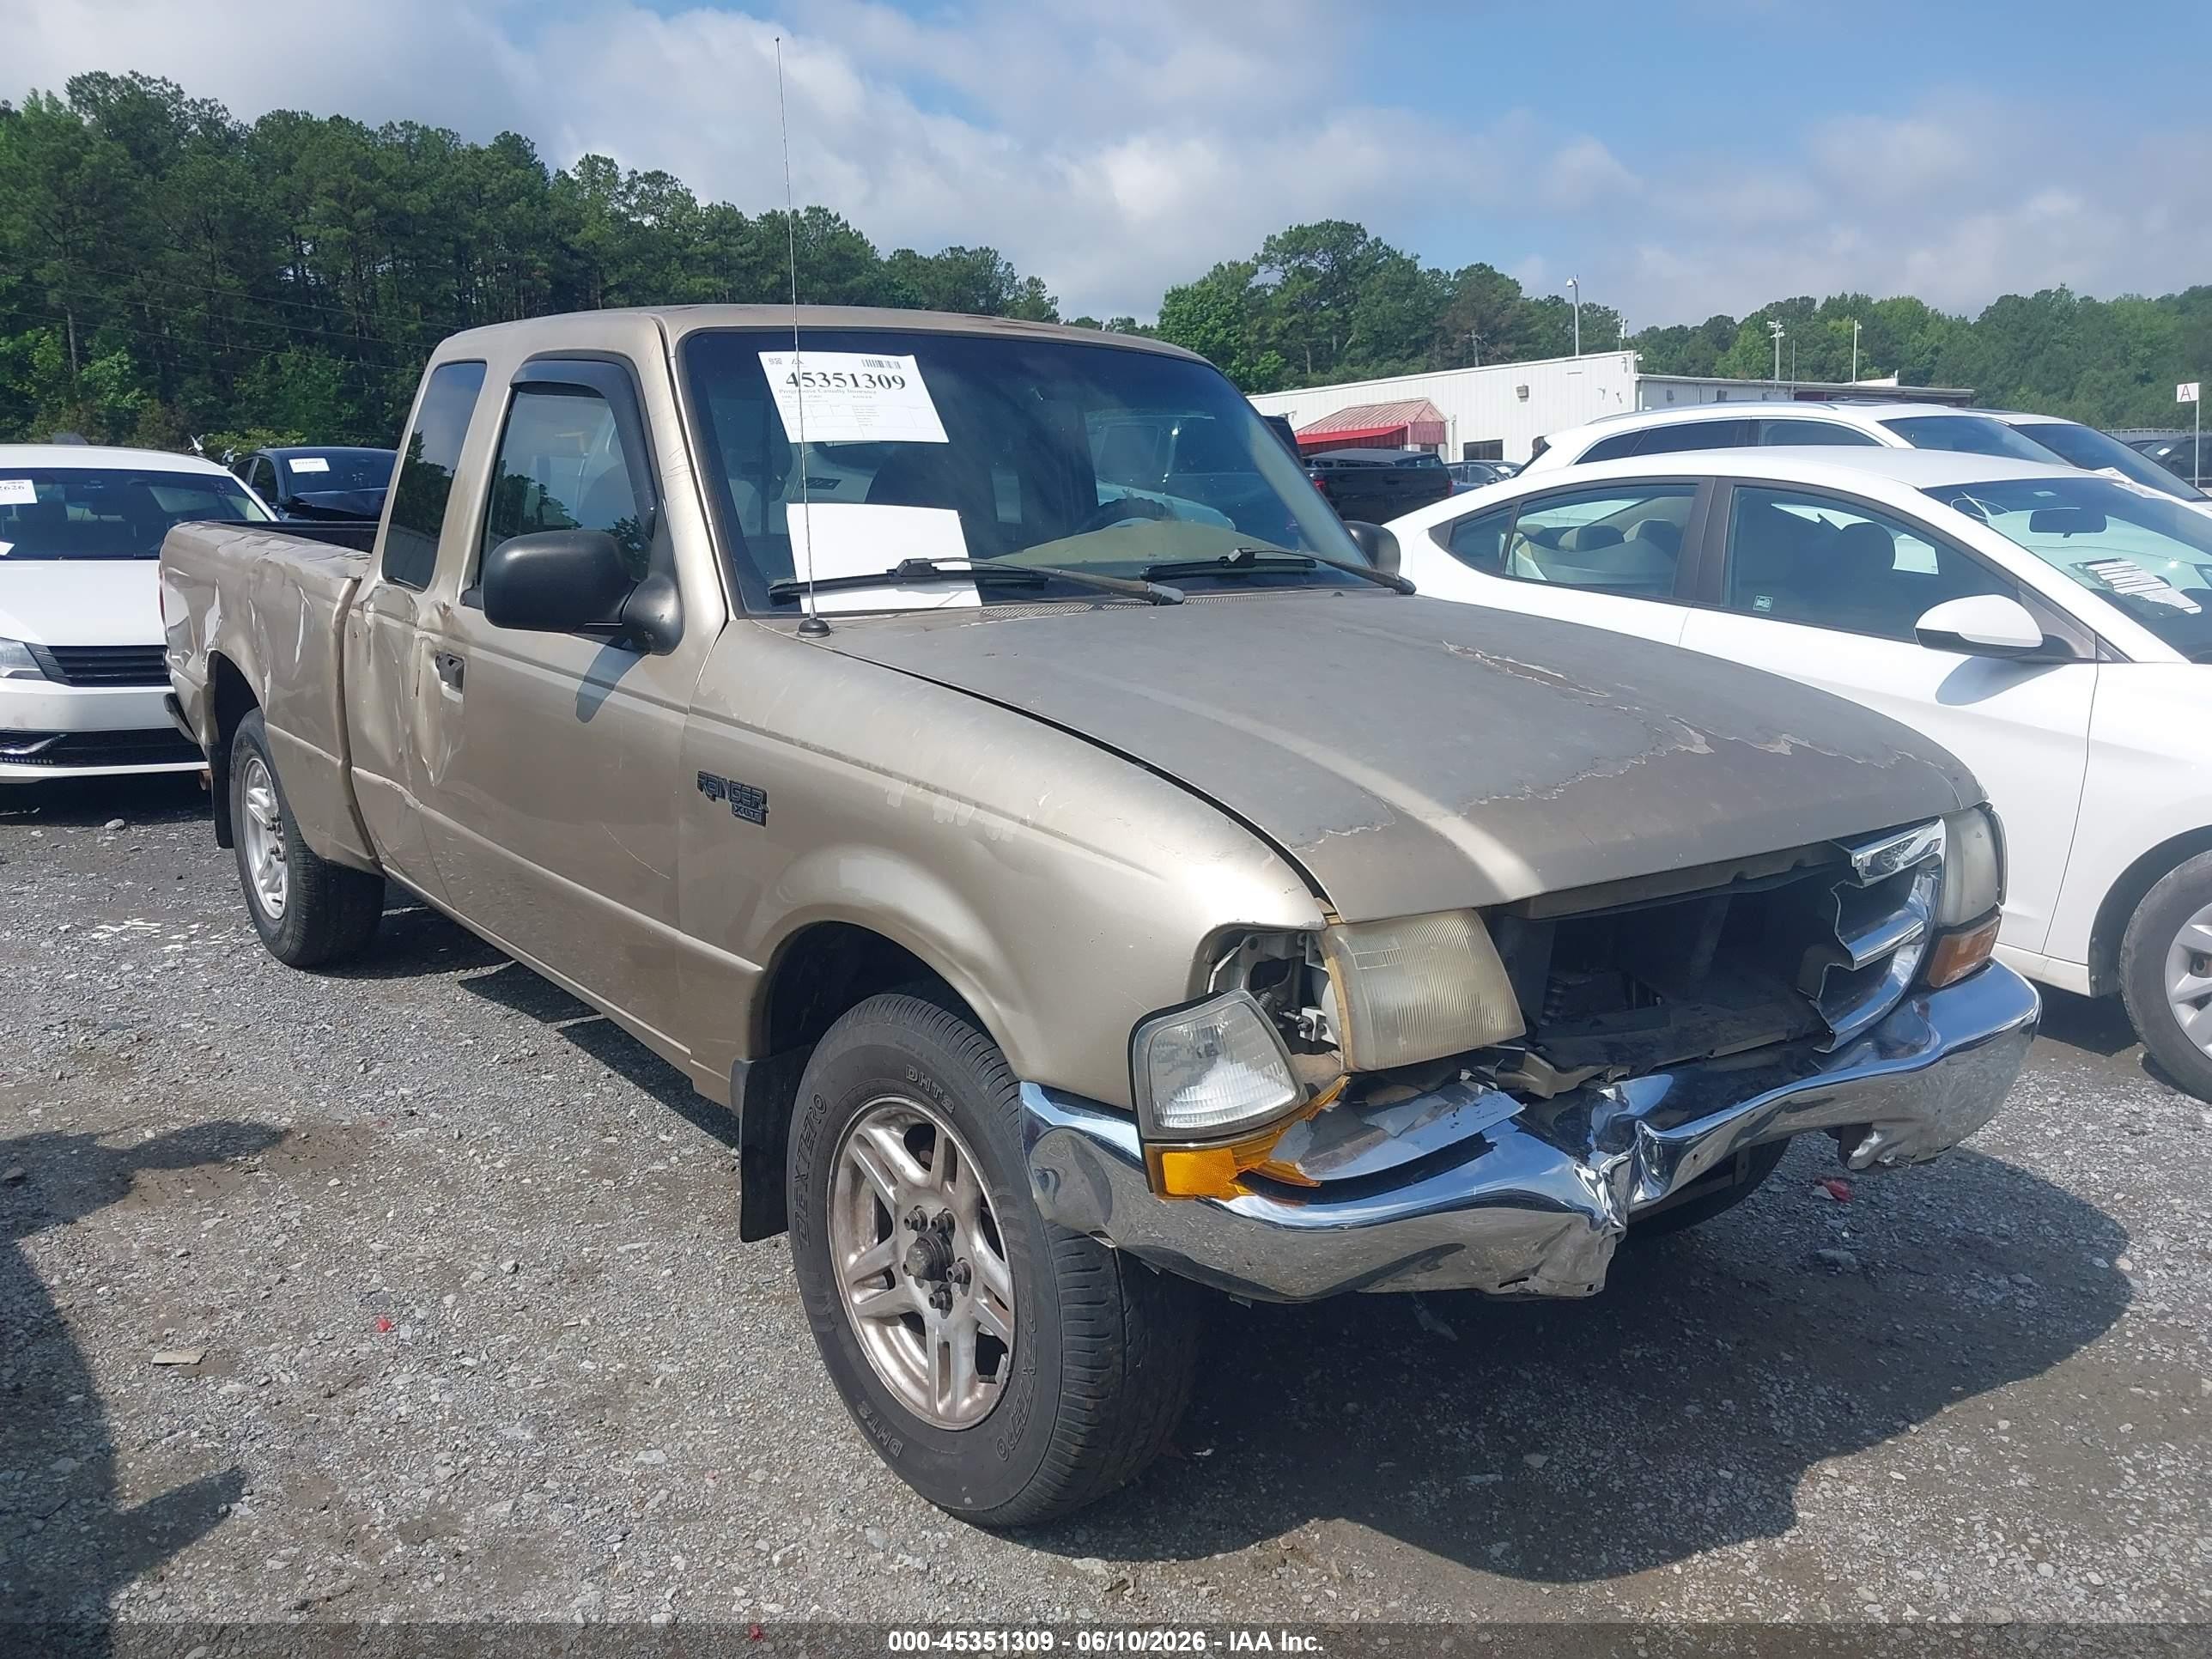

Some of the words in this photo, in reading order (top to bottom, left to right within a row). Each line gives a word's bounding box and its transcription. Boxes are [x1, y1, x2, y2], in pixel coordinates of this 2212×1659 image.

[786, 372, 906, 390] 45351309
[2179, 385, 2192, 401] A
[697, 770, 769, 812] RANGER
[793, 1094, 827, 1250] DEXTERO
